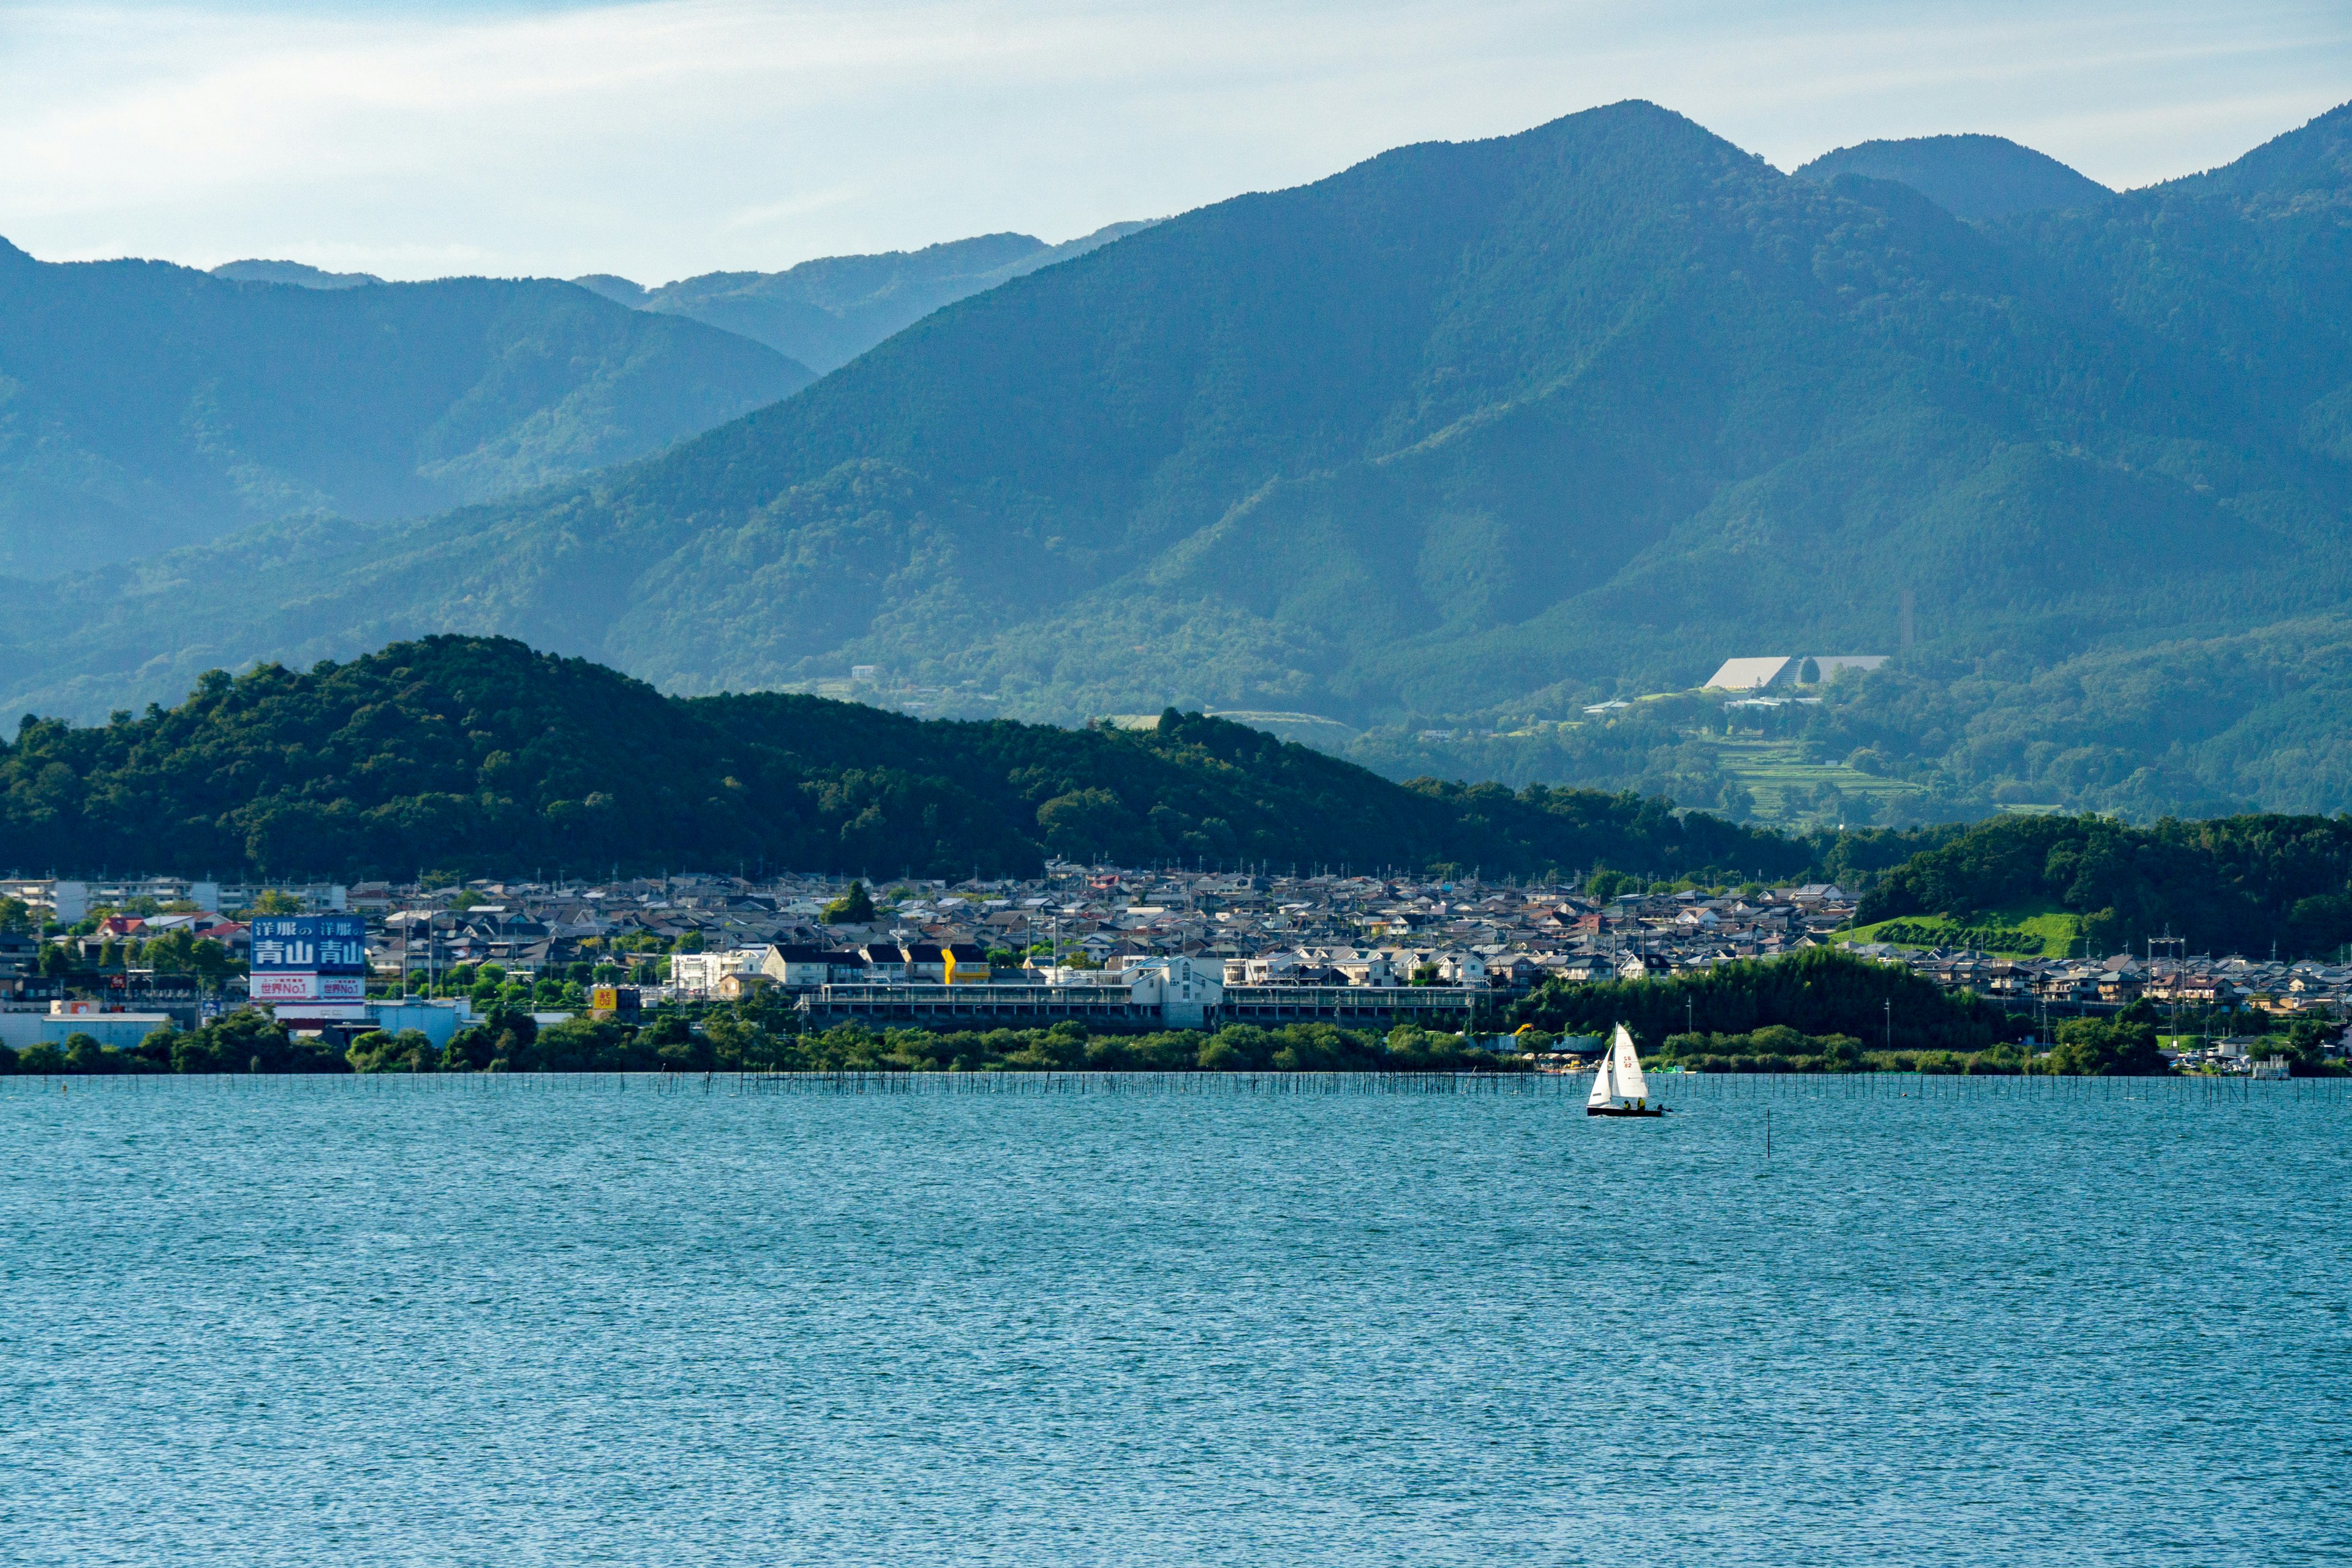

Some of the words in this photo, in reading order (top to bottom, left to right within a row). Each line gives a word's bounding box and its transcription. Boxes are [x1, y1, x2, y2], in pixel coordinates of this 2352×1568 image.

[255, 922, 312, 936] 洋服の
[321, 922, 363, 936] 洋服の
[254, 940, 312, 964] 青山
[319, 940, 363, 964] 青山
[261, 984, 306, 993] 世界No.1
